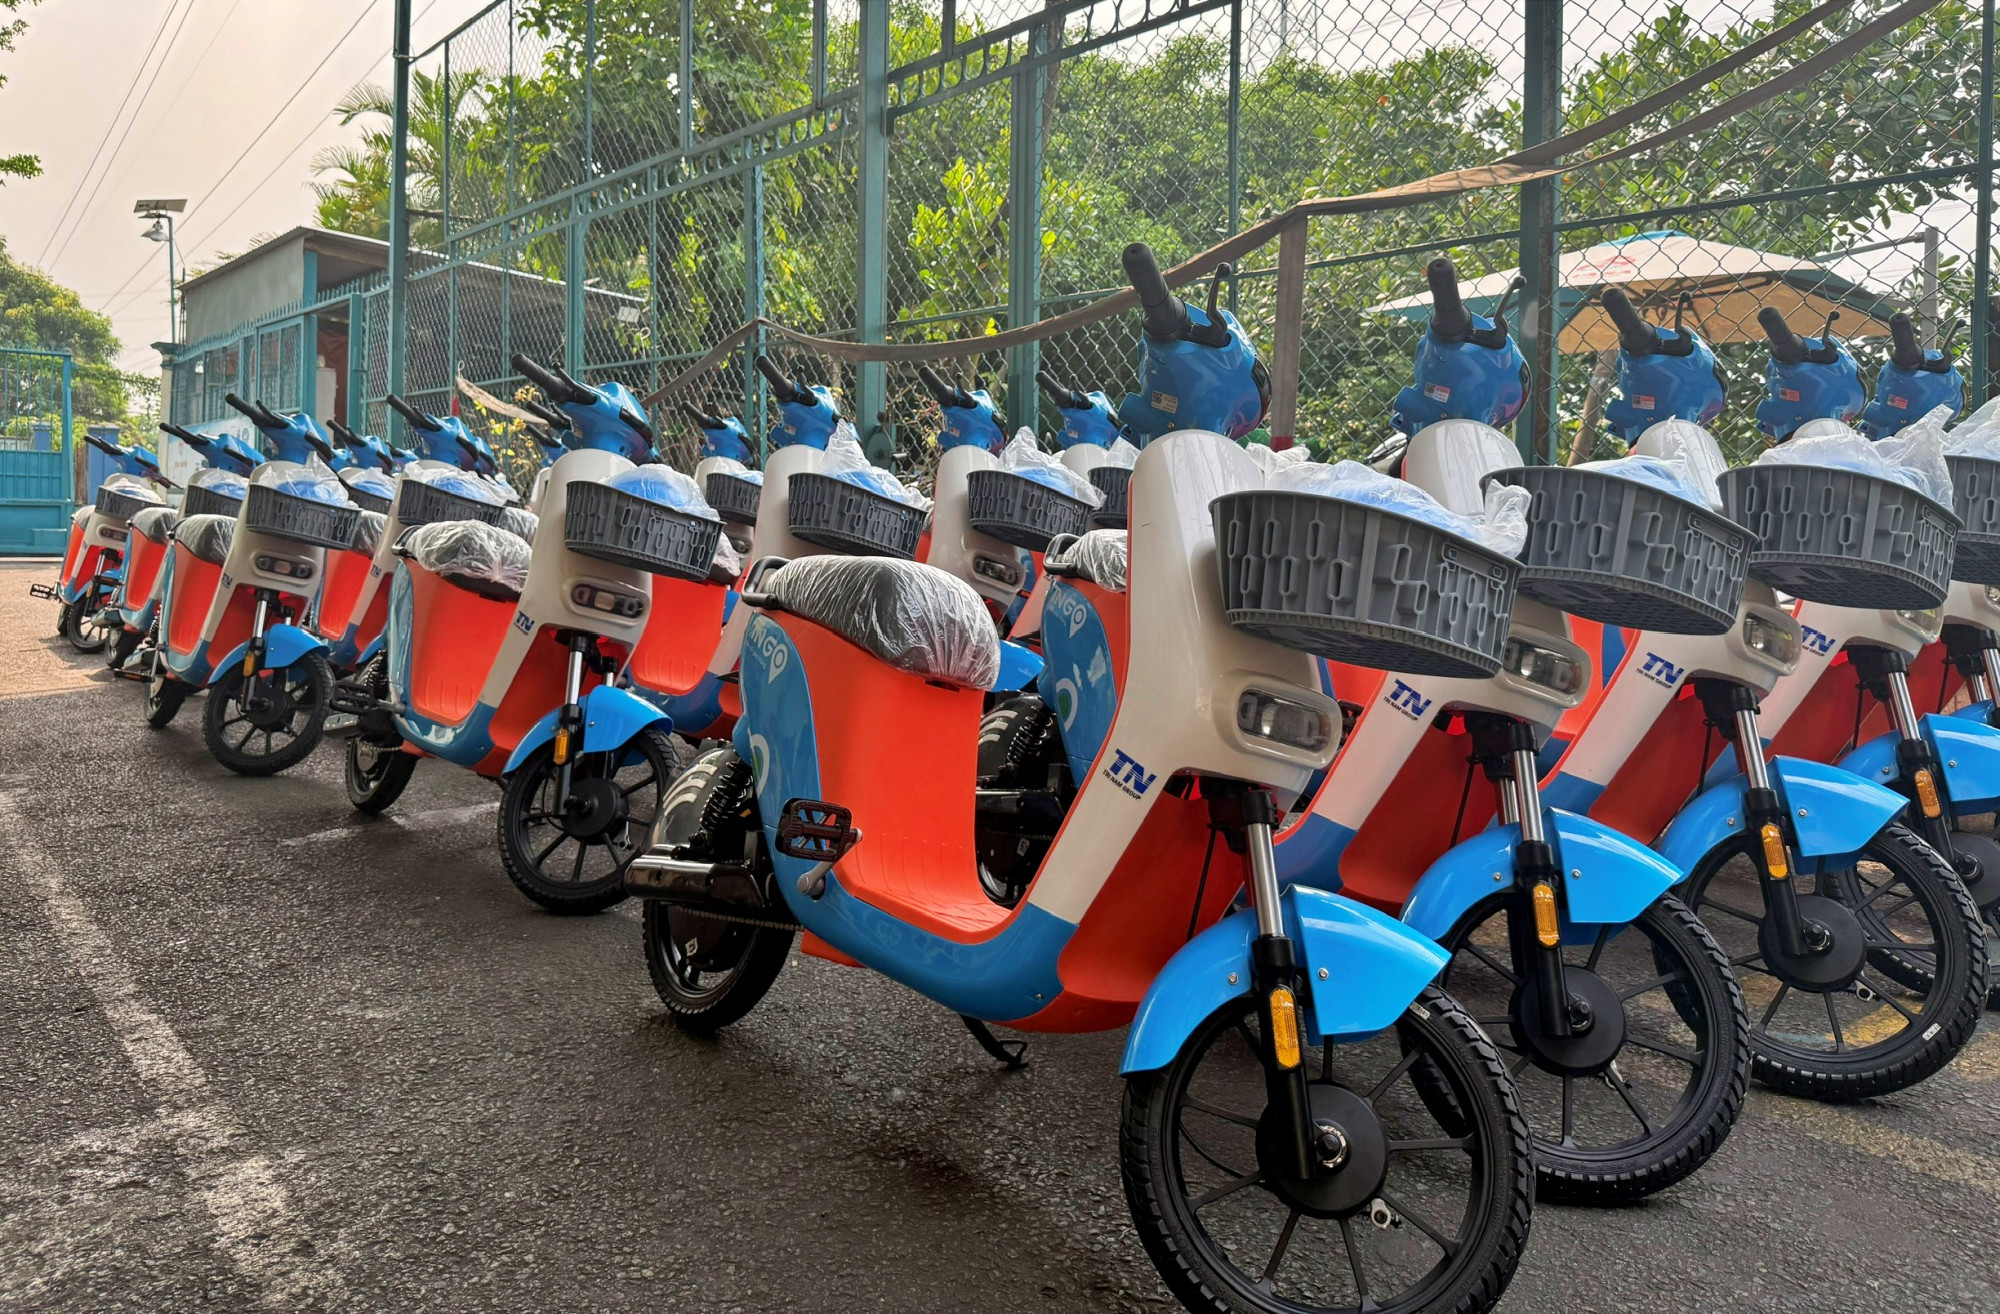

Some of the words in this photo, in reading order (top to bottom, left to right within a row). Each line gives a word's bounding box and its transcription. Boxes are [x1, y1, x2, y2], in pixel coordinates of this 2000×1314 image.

[516, 610, 535, 631] TN
[1801, 624, 1836, 653] TN
[1642, 652, 1685, 684] TN
[1643, 672, 1656, 681] NAM
[1655, 678, 1672, 689] GROUP
[1390, 678, 1432, 717] TN
[1390, 701, 1402, 712] NAM
[1401, 709, 1418, 721] GROUP
[1103, 769, 1112, 779] TRI
[1110, 776, 1123, 788] NAM
[1122, 785, 1142, 800] GROUP
[1109, 748, 1157, 795] TN
